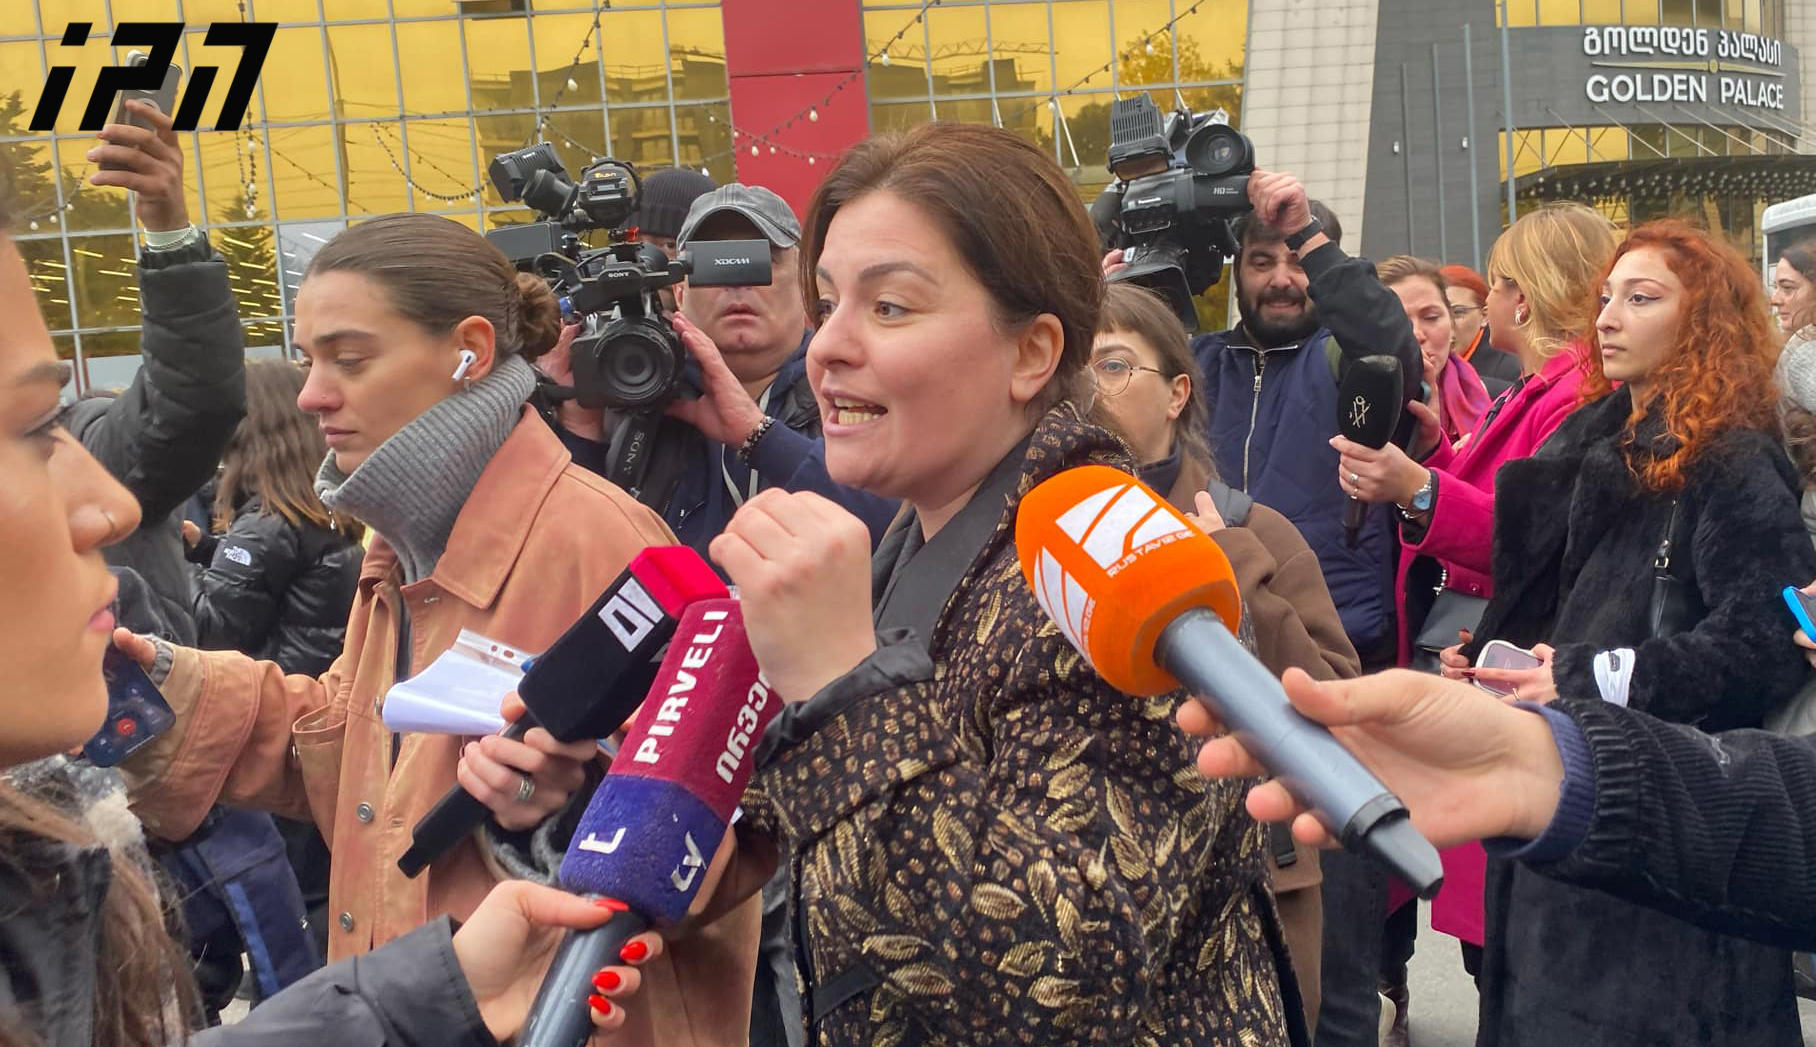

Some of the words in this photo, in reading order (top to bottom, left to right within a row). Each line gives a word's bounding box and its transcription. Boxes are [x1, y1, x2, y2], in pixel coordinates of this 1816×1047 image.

[1583, 26, 1709, 56] გოლდენ
[1718, 30, 1782, 67] პალასი
[1585, 74, 1707, 103] GOLDEN
[1720, 77, 1784, 110] PALACE
[713, 257, 750, 265] XDCAM
[634, 610, 729, 765] PIRVELI
